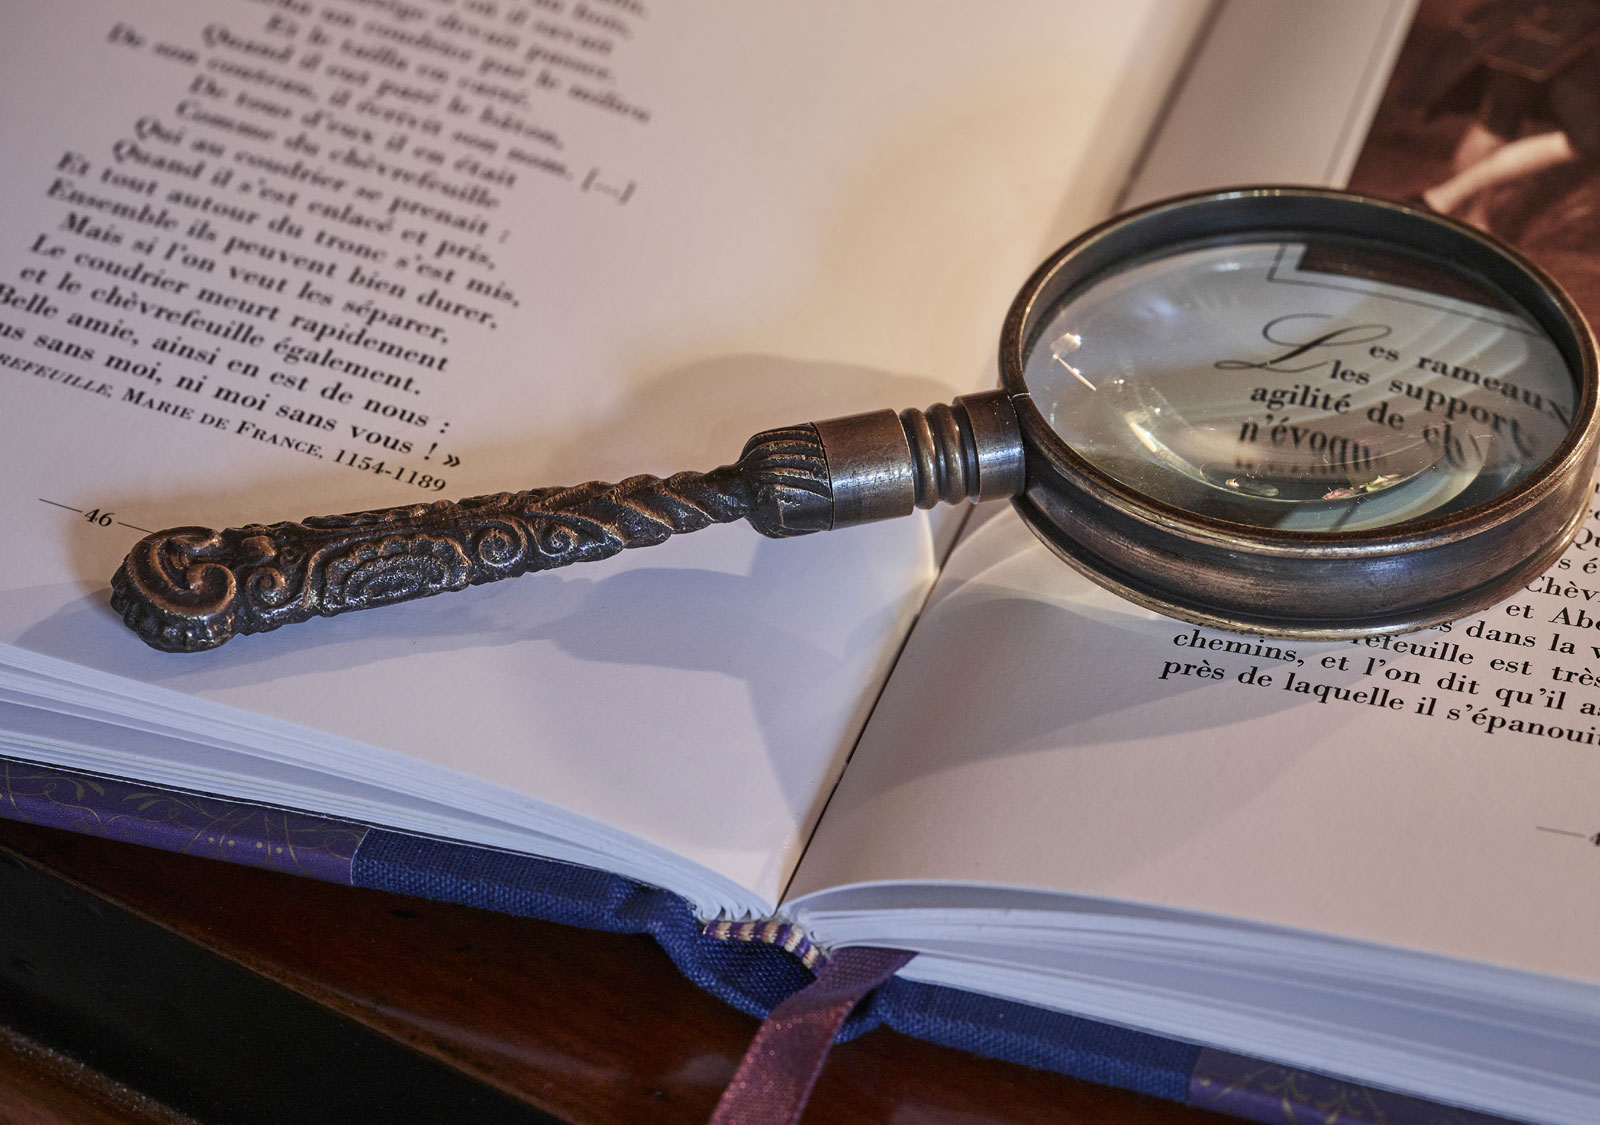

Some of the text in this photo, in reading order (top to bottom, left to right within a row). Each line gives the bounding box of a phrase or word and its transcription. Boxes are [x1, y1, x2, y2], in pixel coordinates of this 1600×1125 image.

[47, 177, 499, 331] Ensemble ils peuvent bien durer,
[58, 210, 450, 346] Mais si l'on veut les séparer,
[19, 266, 421, 395] et le chèvrefeuille également.
[30, 232, 450, 374] Le coudrier meurt rapidement
[0, 283, 59, 319] Belle
[66, 312, 140, 347] amie,
[152, 335, 221, 367] ainsi
[226, 358, 260, 379] en
[269, 370, 310, 393] est
[320, 381, 354, 405] de
[362, 398, 430, 429] nous
[1328, 359, 1371, 387] les
[33, 334, 96, 362] sans
[103, 355, 163, 386] moi,
[175, 375, 208, 395] ni
[212, 386, 270, 412] moi
[275, 404, 338, 432] sans
[349, 424, 415, 455] vous
[1250, 384, 1352, 416] agilité
[1367, 402, 1404, 431] de
[332, 448, 447, 492] 1154-1189
[84, 508, 116, 527] 46
[1506, 604, 1534, 620] et
[1526, 575, 1600, 602] Chèv
[1173, 628, 1305, 668] chemins,
[1320, 656, 1351, 672] et
[1362, 657, 1421, 685] l'on
[1437, 672, 1480, 696] dit
[1495, 687, 1567, 712] qu'il
[1466, 620, 1536, 648] dans
[1548, 633, 1576, 655] la
[1490, 657, 1533, 676] est
[1158, 659, 1600, 747] près de laquelle il s'épanoui
